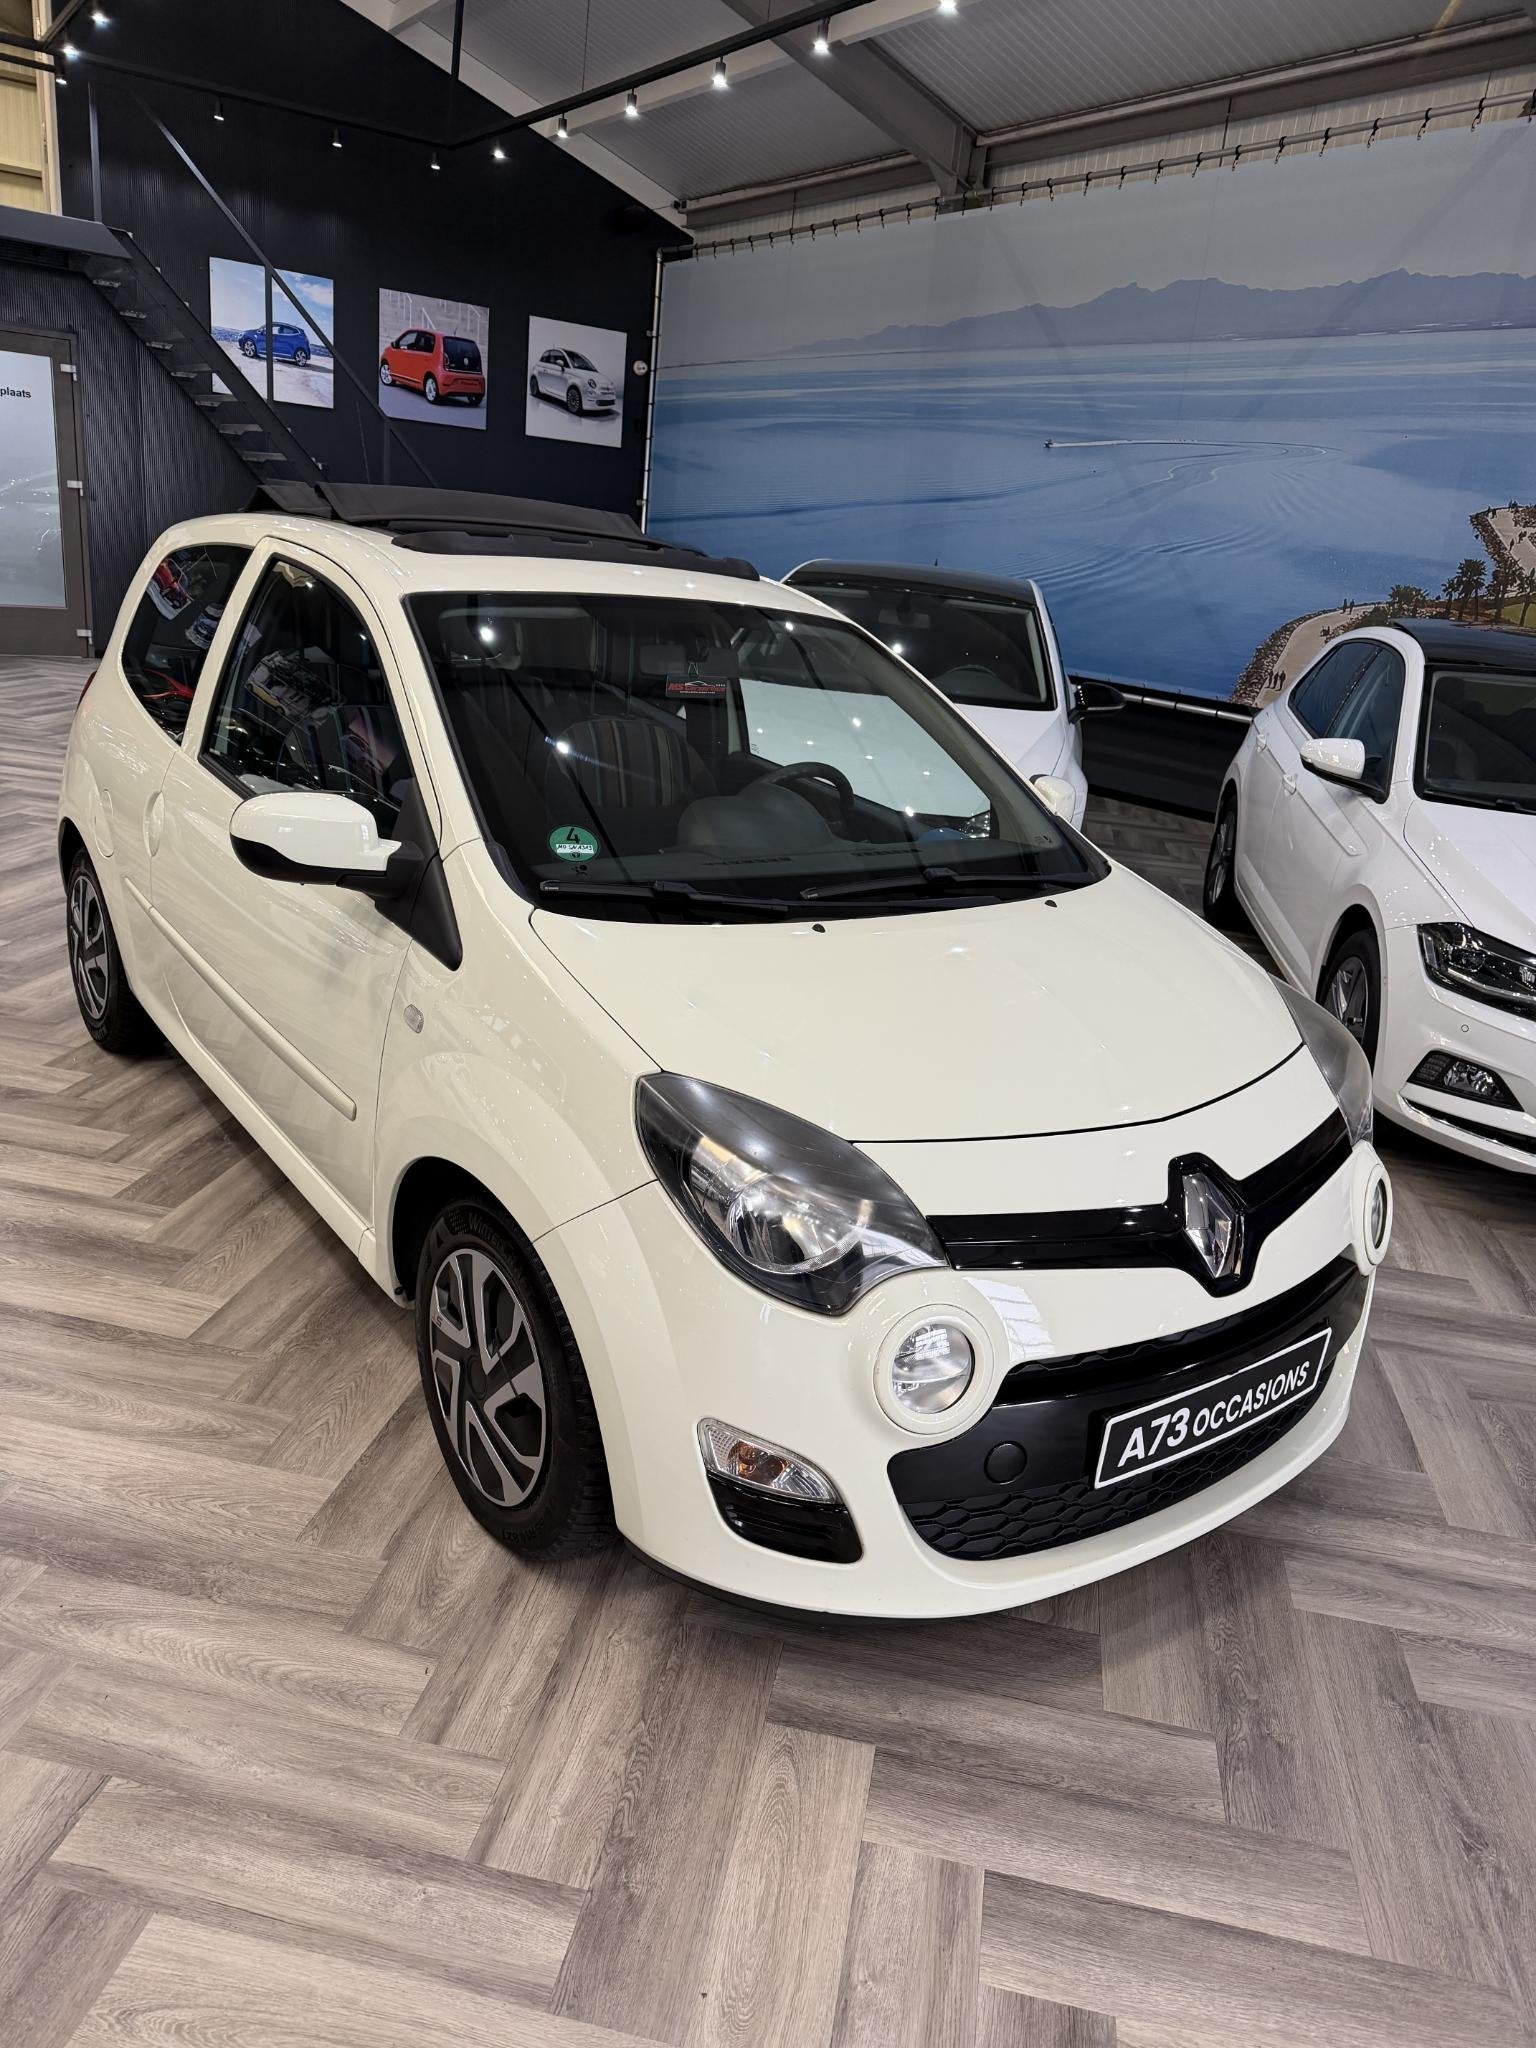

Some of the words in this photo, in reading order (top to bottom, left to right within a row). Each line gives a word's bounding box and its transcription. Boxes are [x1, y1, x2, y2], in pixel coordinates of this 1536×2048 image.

[0, 387, 31, 398] plaats
[567, 828, 580, 844] 4
[1117, 1407, 1191, 1468] A73
[1192, 1360, 1310, 1437] OCCASIONS
